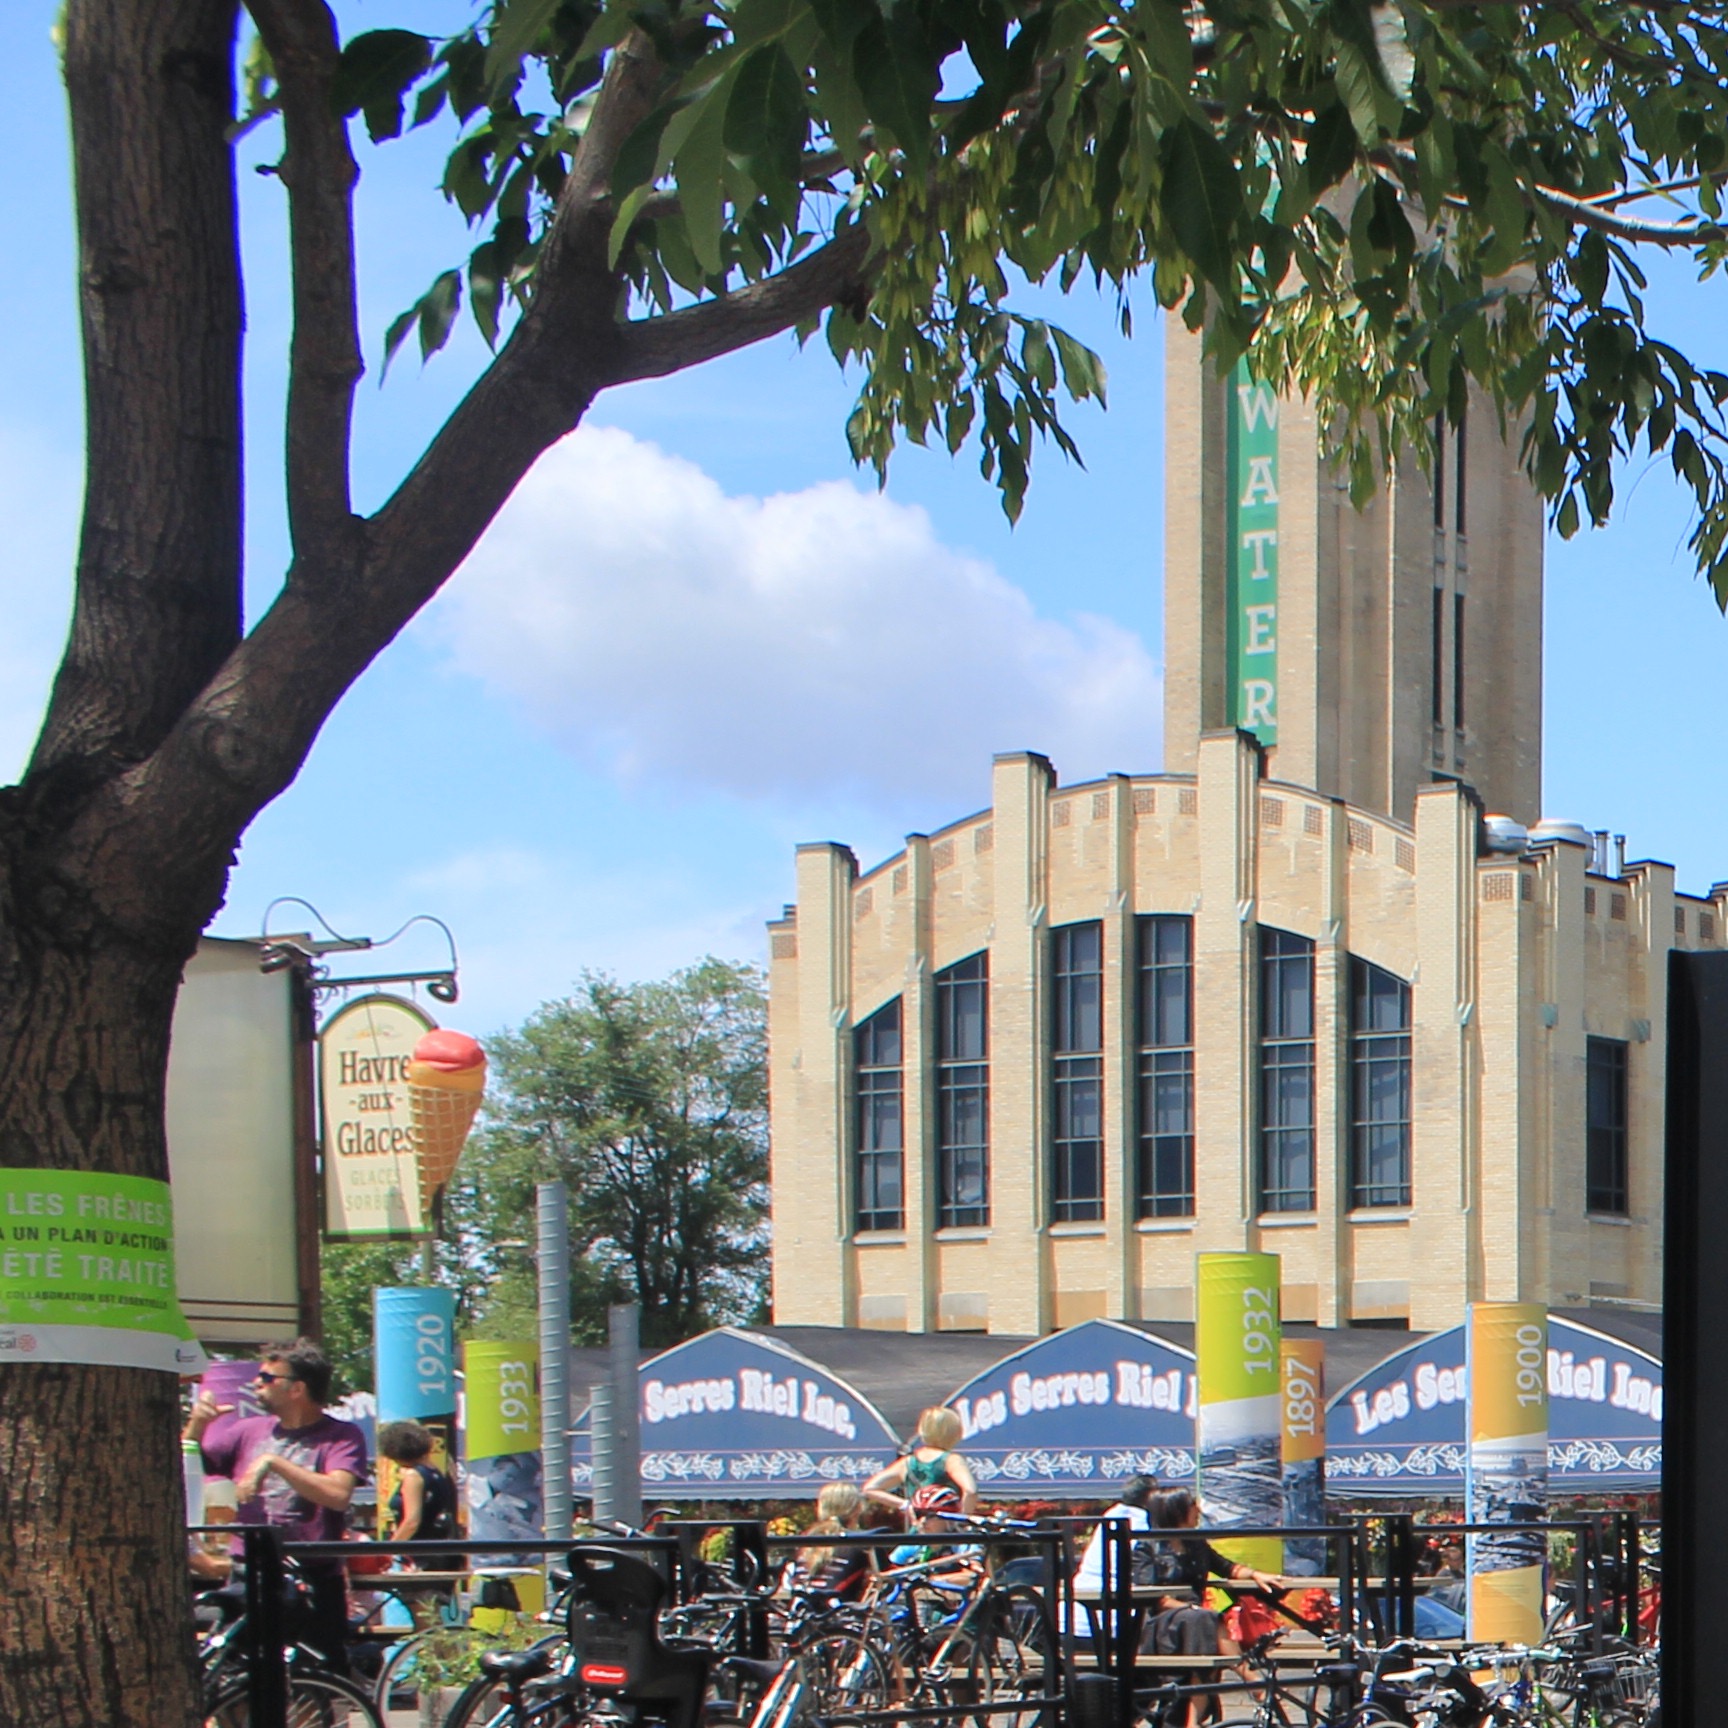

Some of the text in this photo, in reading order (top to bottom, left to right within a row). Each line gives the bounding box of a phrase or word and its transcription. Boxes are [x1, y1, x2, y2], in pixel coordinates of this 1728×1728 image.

[339, 1050, 412, 1085] Havre
[338, 1121, 415, 1157] Glaces
[8, 1193, 166, 1226] LES FRÊNES
[13, 1227, 39, 1241] UN
[48, 1227, 97, 1243] PLAN
[104, 1231, 168, 1251] D'ACTION
[78, 1254, 169, 1288] TRAITÉ
[416, 1314, 446, 1397] 1920
[1243, 1287, 1273, 1375] 1932
[1516, 1324, 1543, 1408] 1900
[500, 1360, 530, 1435] 1933
[645, 1377, 735, 1423] Serres
[739, 1368, 799, 1418] Riel
[956, 1391, 1008, 1441] Les
[1010, 1371, 1110, 1417] Serres
[1115, 1360, 1181, 1412] Riel
[1286, 1357, 1316, 1438] 1897
[1352, 1381, 1410, 1436] Les
